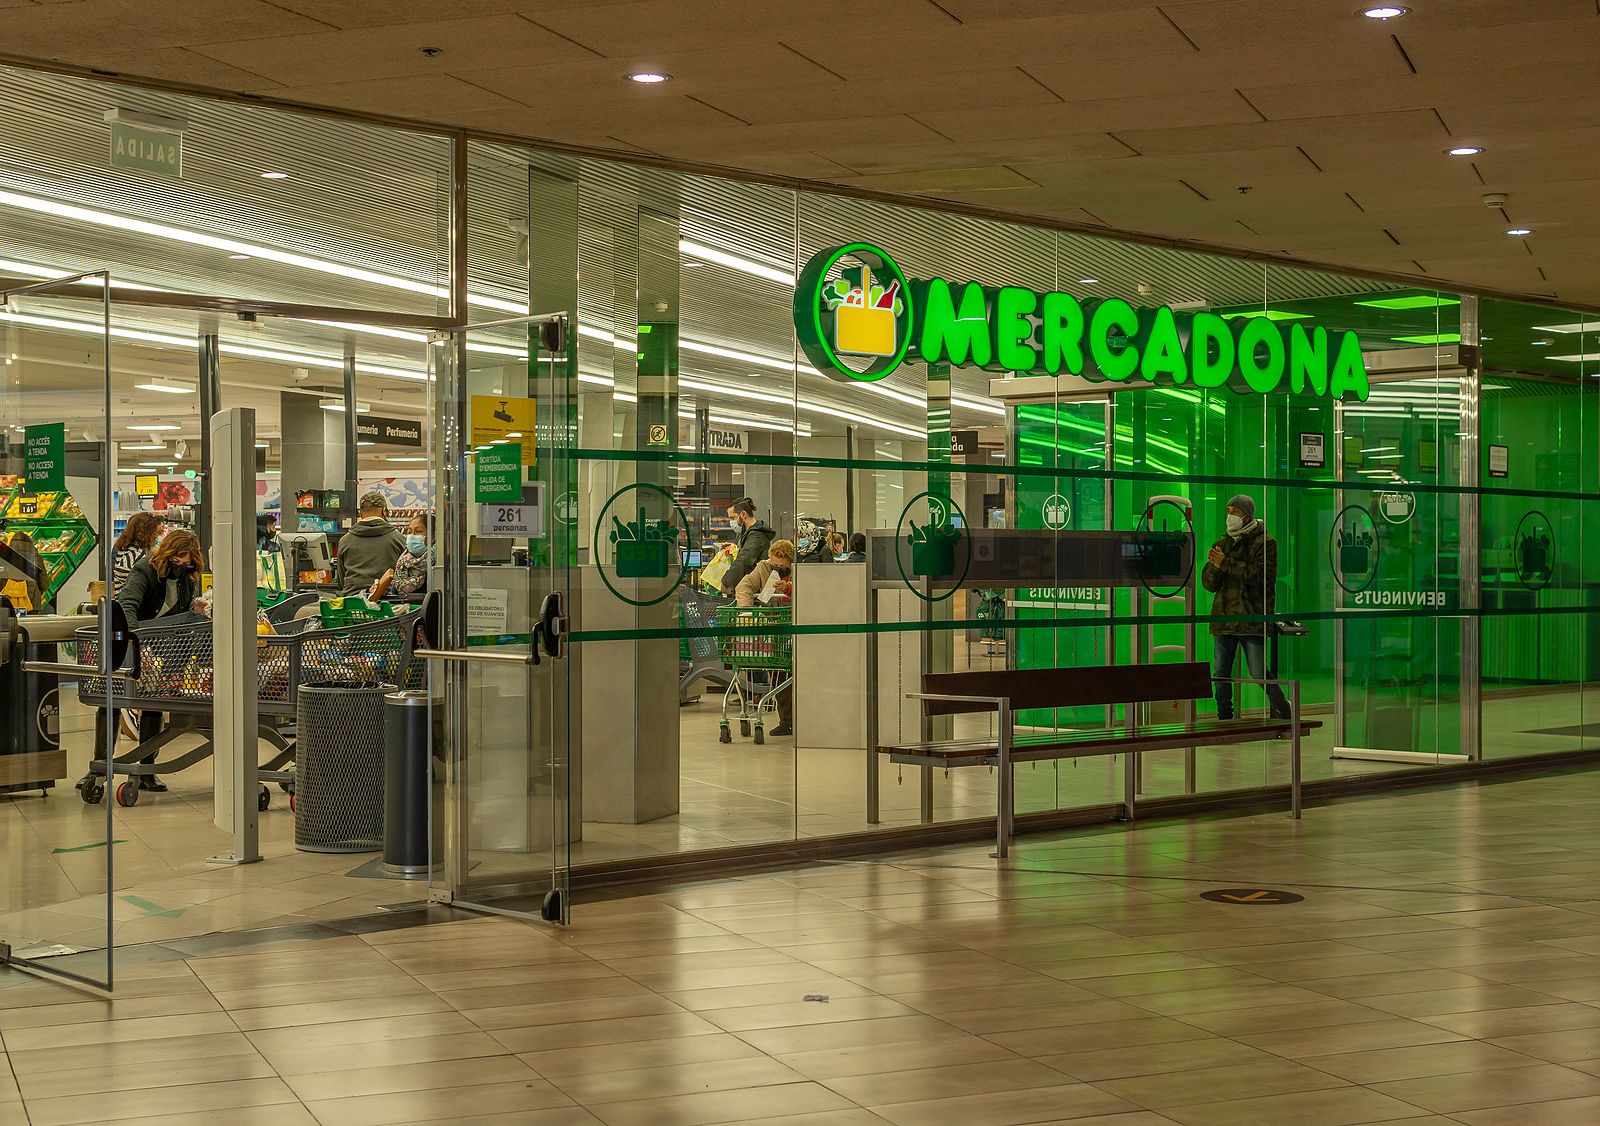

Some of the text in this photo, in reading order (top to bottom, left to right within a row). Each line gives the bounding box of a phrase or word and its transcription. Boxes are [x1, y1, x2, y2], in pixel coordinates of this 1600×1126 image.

[919, 276, 1369, 401] MERCADONA
[28, 439, 35, 447] NO
[32, 448, 47, 456] TENDA
[28, 460, 54, 470] NO ACCESO
[33, 471, 48, 479] TIENDA
[479, 475, 505, 484] SALIDA DE
[479, 484, 512, 492] EMERGENCIA
[497, 508, 521, 522] 261
